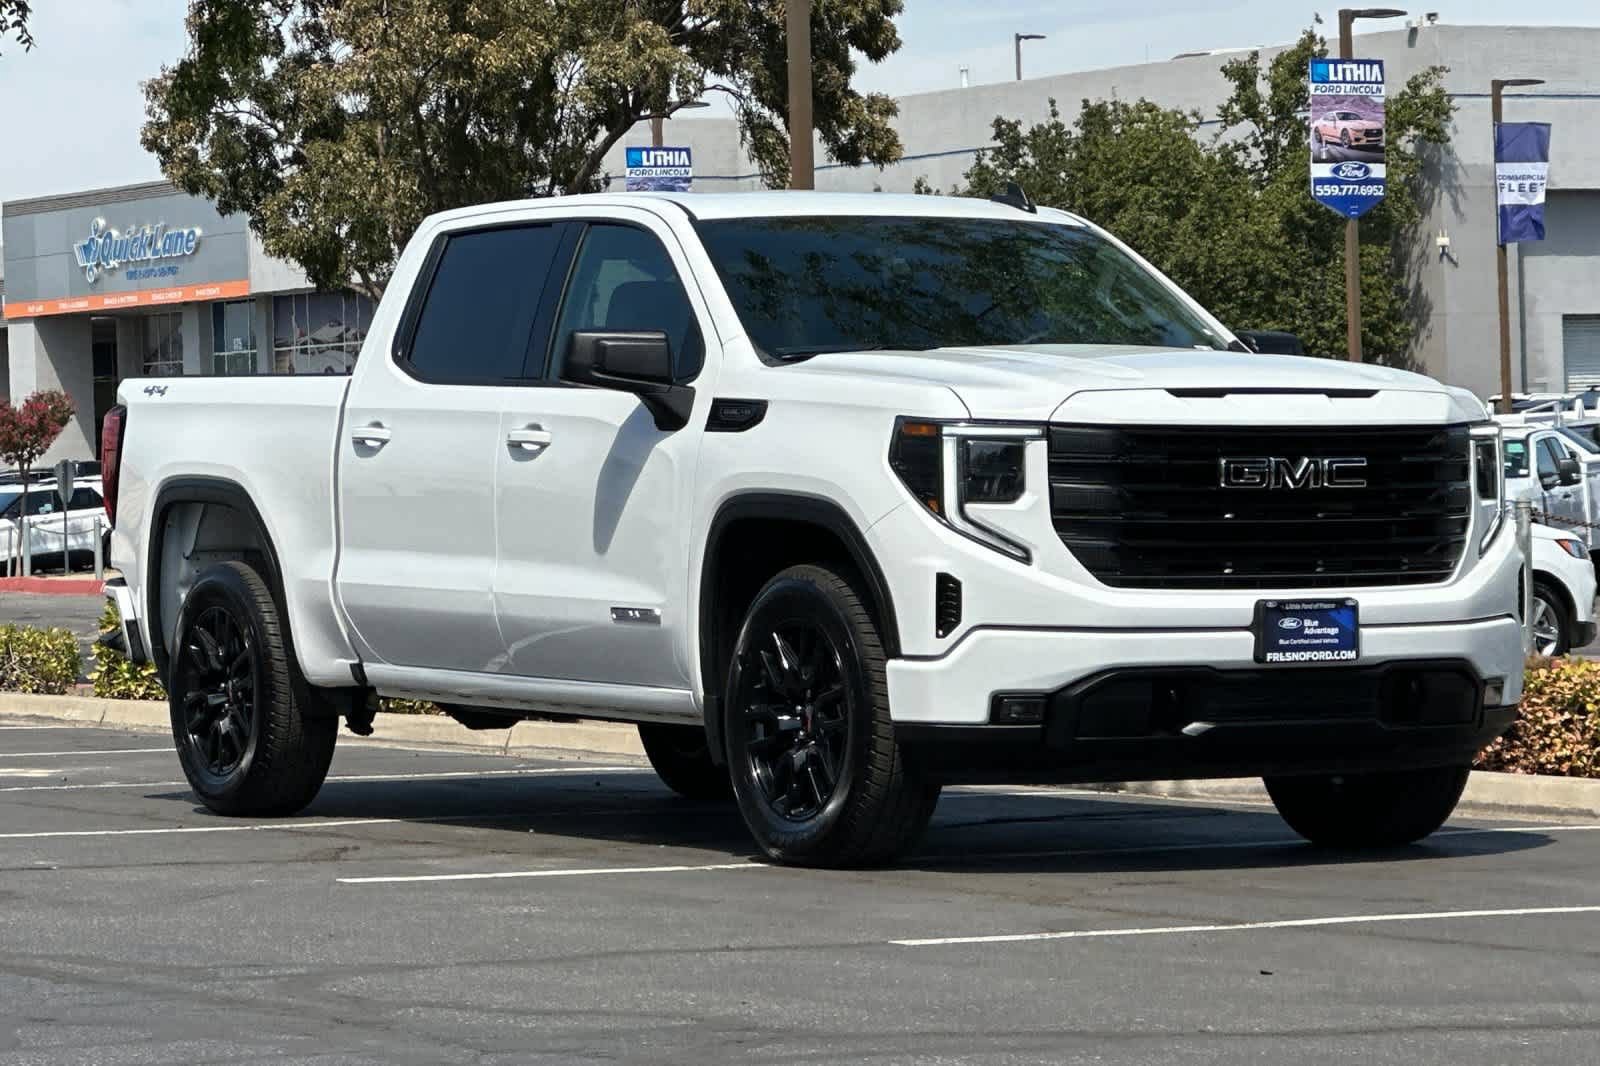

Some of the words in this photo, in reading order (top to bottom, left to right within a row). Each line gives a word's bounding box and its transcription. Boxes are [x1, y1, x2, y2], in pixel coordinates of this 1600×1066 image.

[1328, 63, 1383, 82] LITHIA
[1314, 85, 1342, 94] FORD
[1343, 85, 1383, 94] LINCOLN
[641, 150, 690, 167] LITHIA
[629, 168, 654, 177] FORD
[655, 168, 690, 177] LINCOLN
[1339, 162, 1366, 178] Ford
[1315, 184, 1385, 197] 559.777.6952
[100, 225, 149, 269] Quick
[150, 224, 198, 257] Lane
[1219, 456, 1368, 490] GMC
[1303, 619, 1319, 627] Blue
[1303, 627, 1340, 635] Advantage
[1266, 650, 1357, 662] FRESNOFORD.COM
